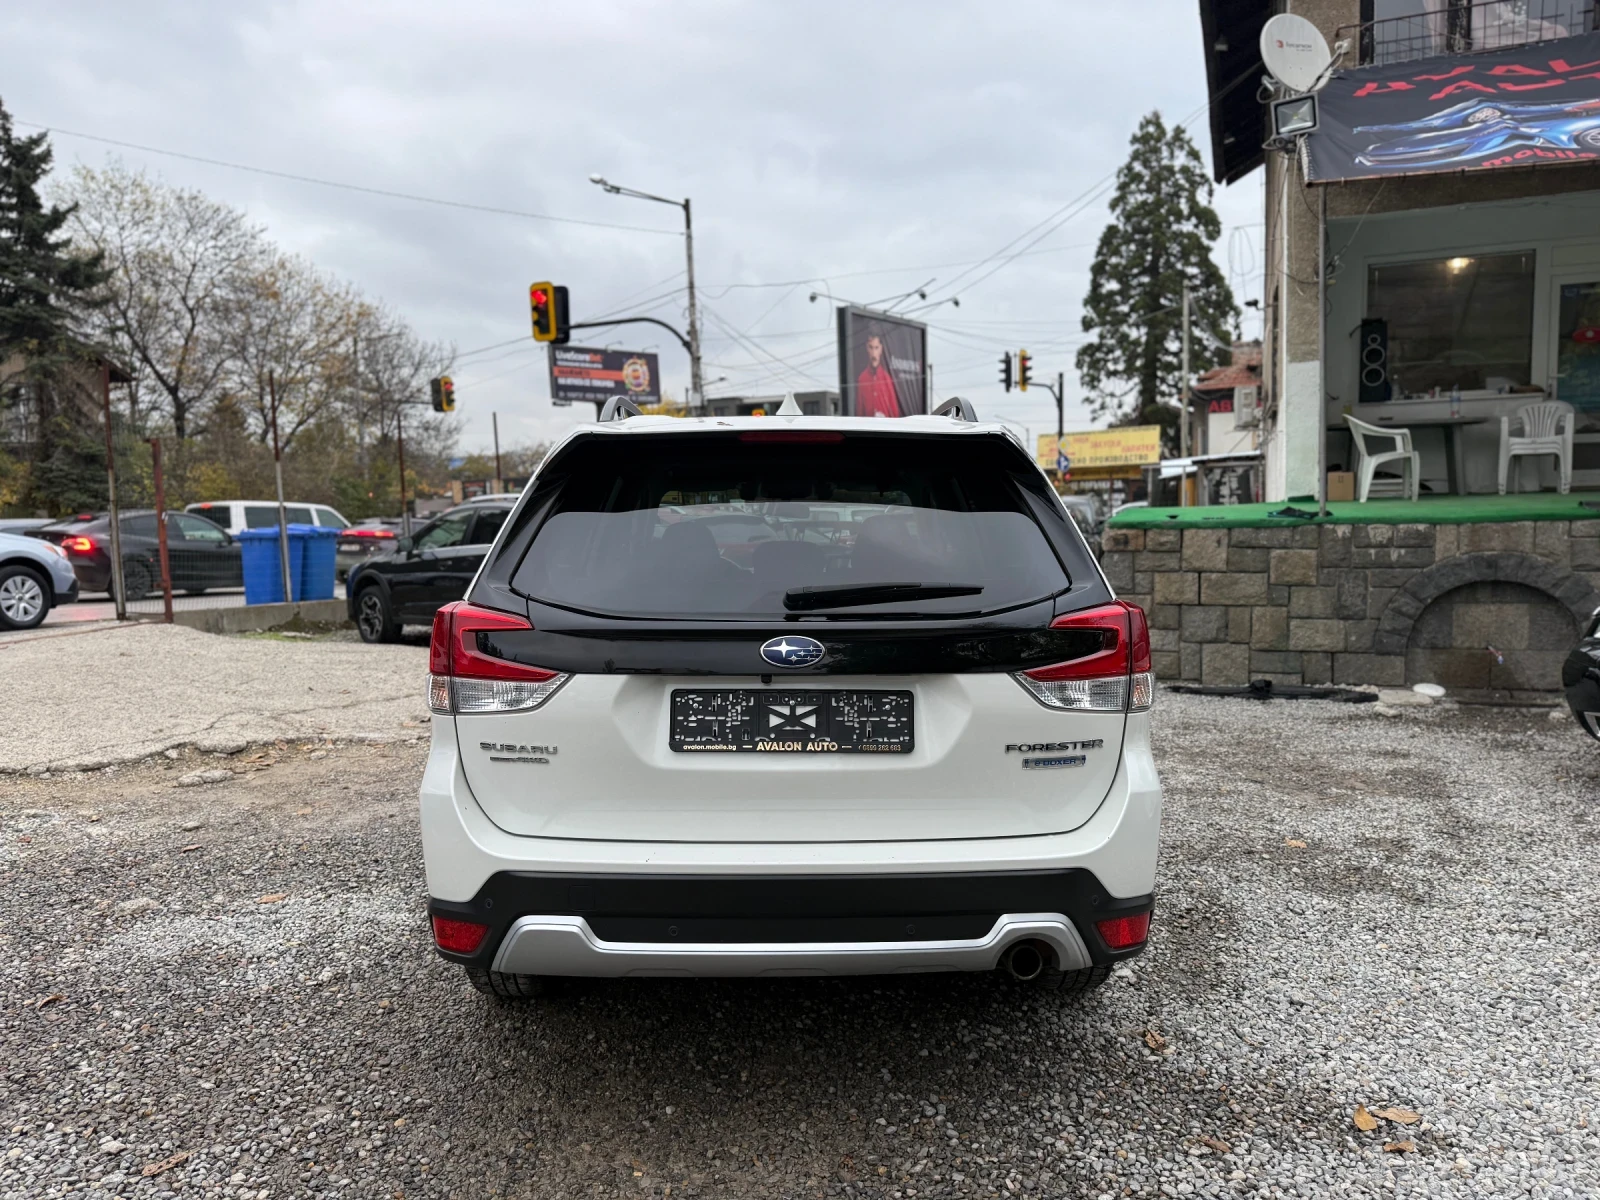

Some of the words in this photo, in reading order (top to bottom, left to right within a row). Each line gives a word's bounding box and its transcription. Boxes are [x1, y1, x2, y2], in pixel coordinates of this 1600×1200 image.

[480, 742, 558, 755] SUBARU
[756, 741, 802, 751] AVALON
[806, 741, 838, 751] AUTO
[1005, 738, 1104, 754] FORESTER
